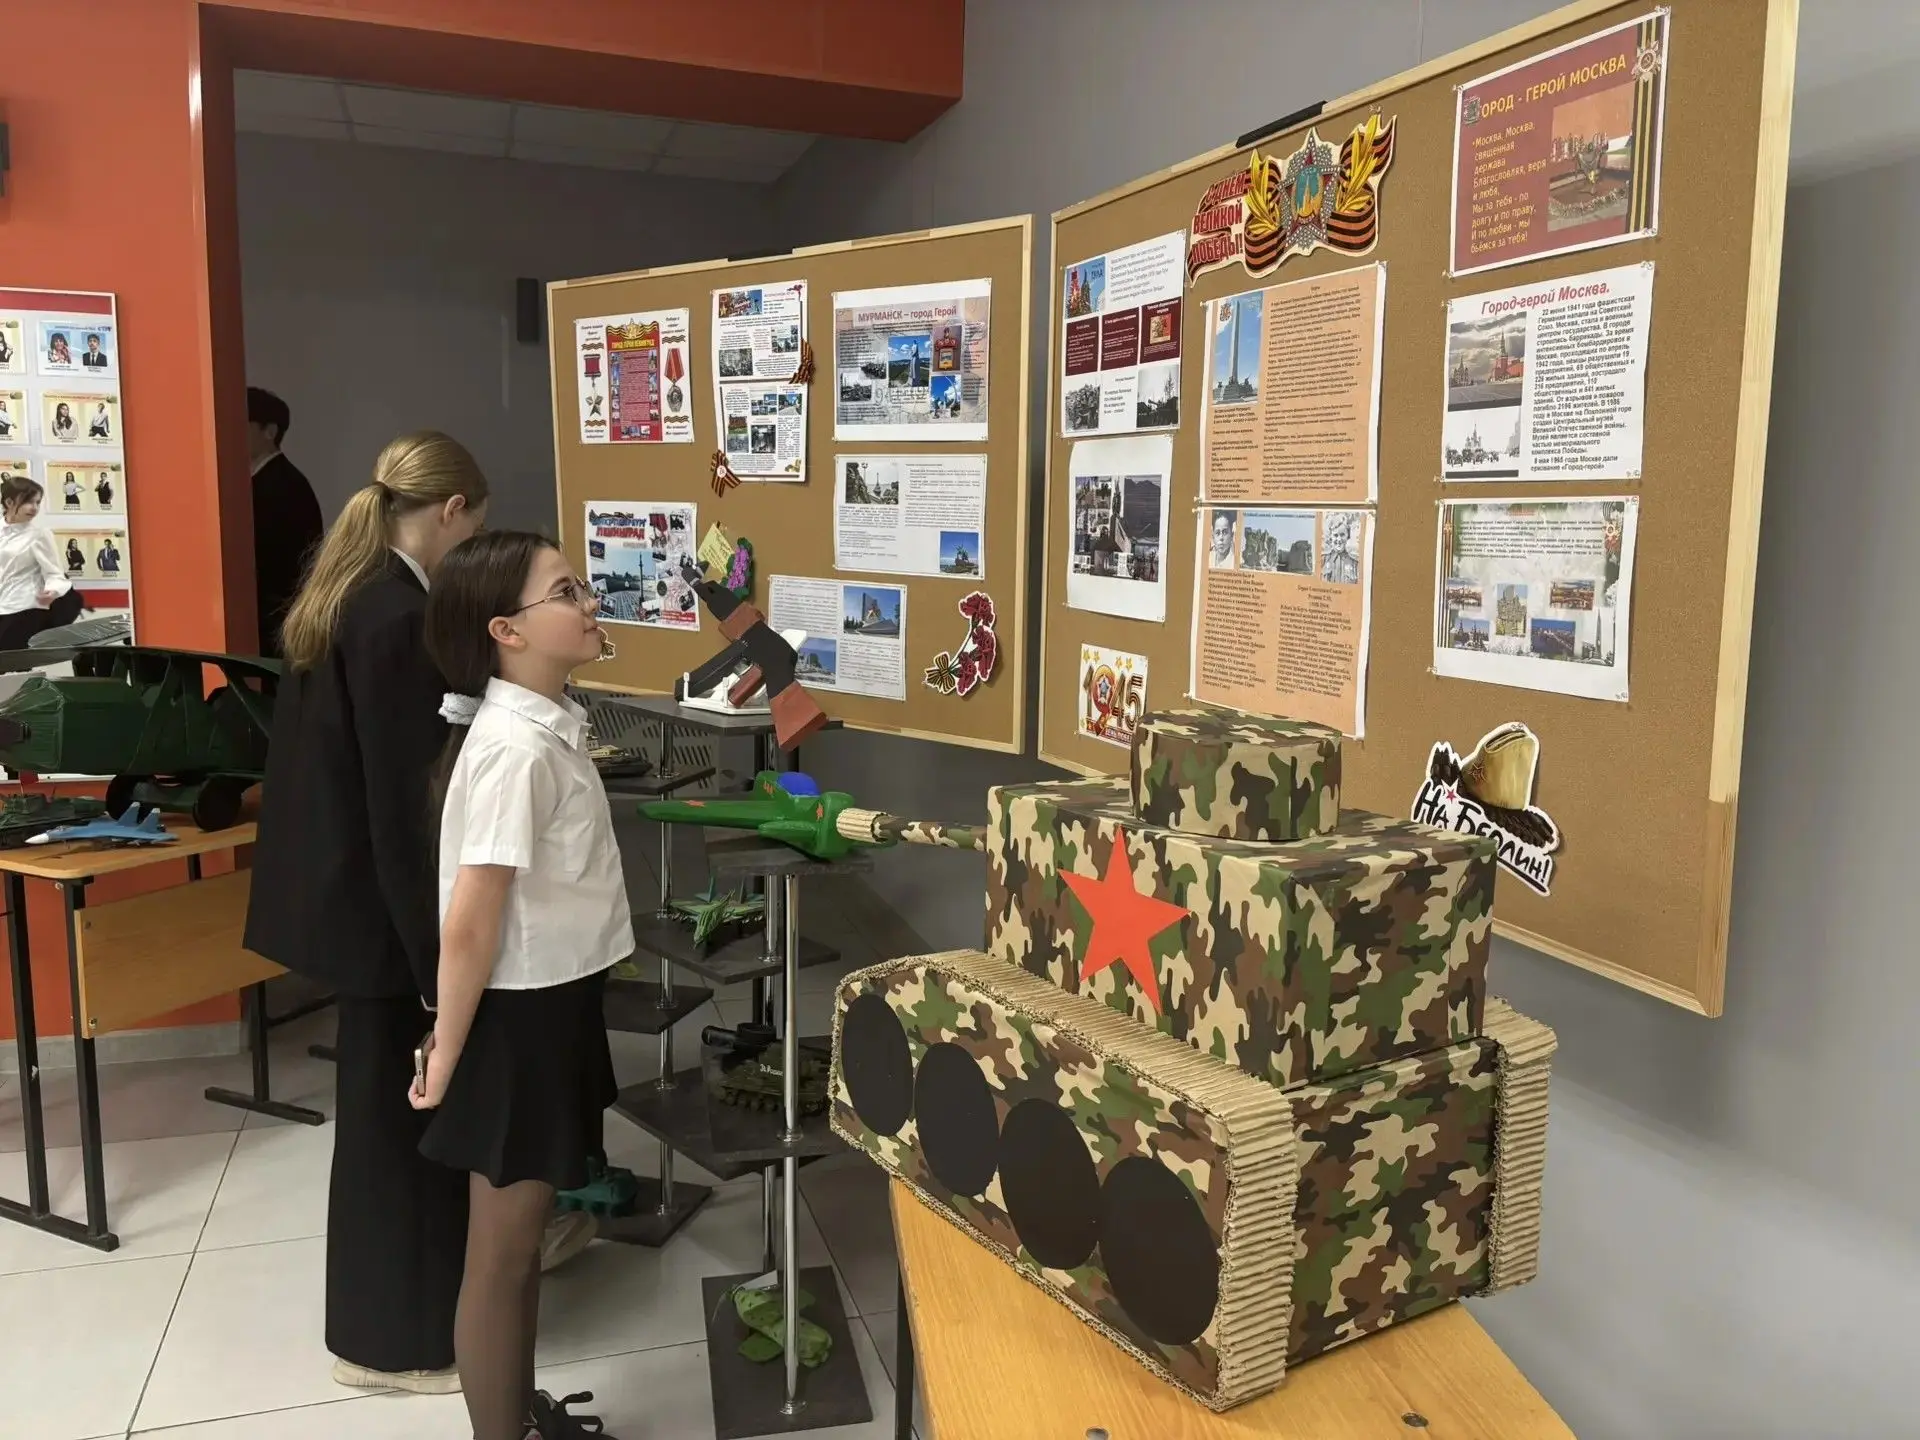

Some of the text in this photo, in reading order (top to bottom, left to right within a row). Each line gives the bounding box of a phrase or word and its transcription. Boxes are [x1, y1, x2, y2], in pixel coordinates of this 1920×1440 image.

[1480, 94, 1514, 118] ОРОД
[1526, 73, 1565, 102] ГЕРОЙ
[1570, 54, 1626, 87] МОСКВА
[1528, 159, 1546, 172] веря
[1473, 204, 1483, 214] Мы
[1486, 202, 1493, 210] за
[1496, 195, 1512, 208] тебя
[1519, 192, 1528, 202] по
[1193, 198, 1242, 234] ВЕЛИКОЙ
[1472, 215, 1492, 229] долгу
[1501, 211, 1510, 219] по
[1472, 231, 1476, 240] И
[1478, 230, 1487, 238] по
[1489, 223, 1511, 236] любви
[1519, 218, 1530, 229] мы
[1498, 238, 1505, 247] за
[1508, 231, 1528, 244] тебя!
[1192, 233, 1243, 264] ПОБЕДЫ!
[1481, 283, 1610, 316] Город-герой Москва.
[1597, 296, 1635, 307] фашистская
[858, 310, 902, 322] МУРМАНСК
[910, 310, 932, 319] город
[934, 306, 956, 317] Герой
[1538, 315, 1565, 324] Германия
[1599, 304, 1631, 314] Советский
[1581, 317, 1598, 325] стала
[1605, 312, 1633, 320] военным
[1537, 330, 1561, 338] центром
[1609, 320, 1630, 329] городе
[1537, 338, 1567, 346] строились
[1615, 327, 1634, 336] время
[1577, 337, 1625, 348] бомбардировок
[1536, 360, 1548, 368] 1942
[1588, 353, 1621, 363] разрушили
[1585, 359, 1629, 369] общественных
[1534, 388, 1577, 397] общественных
[1565, 394, 1592, 402] взрывов
[1599, 392, 1624, 400] пожаров
[1584, 406, 1617, 415] Поклонной
[1553, 416, 1595, 425] Центральный
[1596, 414, 1613, 424] музей
[1557, 423, 1603, 432] Отечественной
[1553, 439, 1601, 447] мемориального
[1083, 664, 1143, 731] 1945
